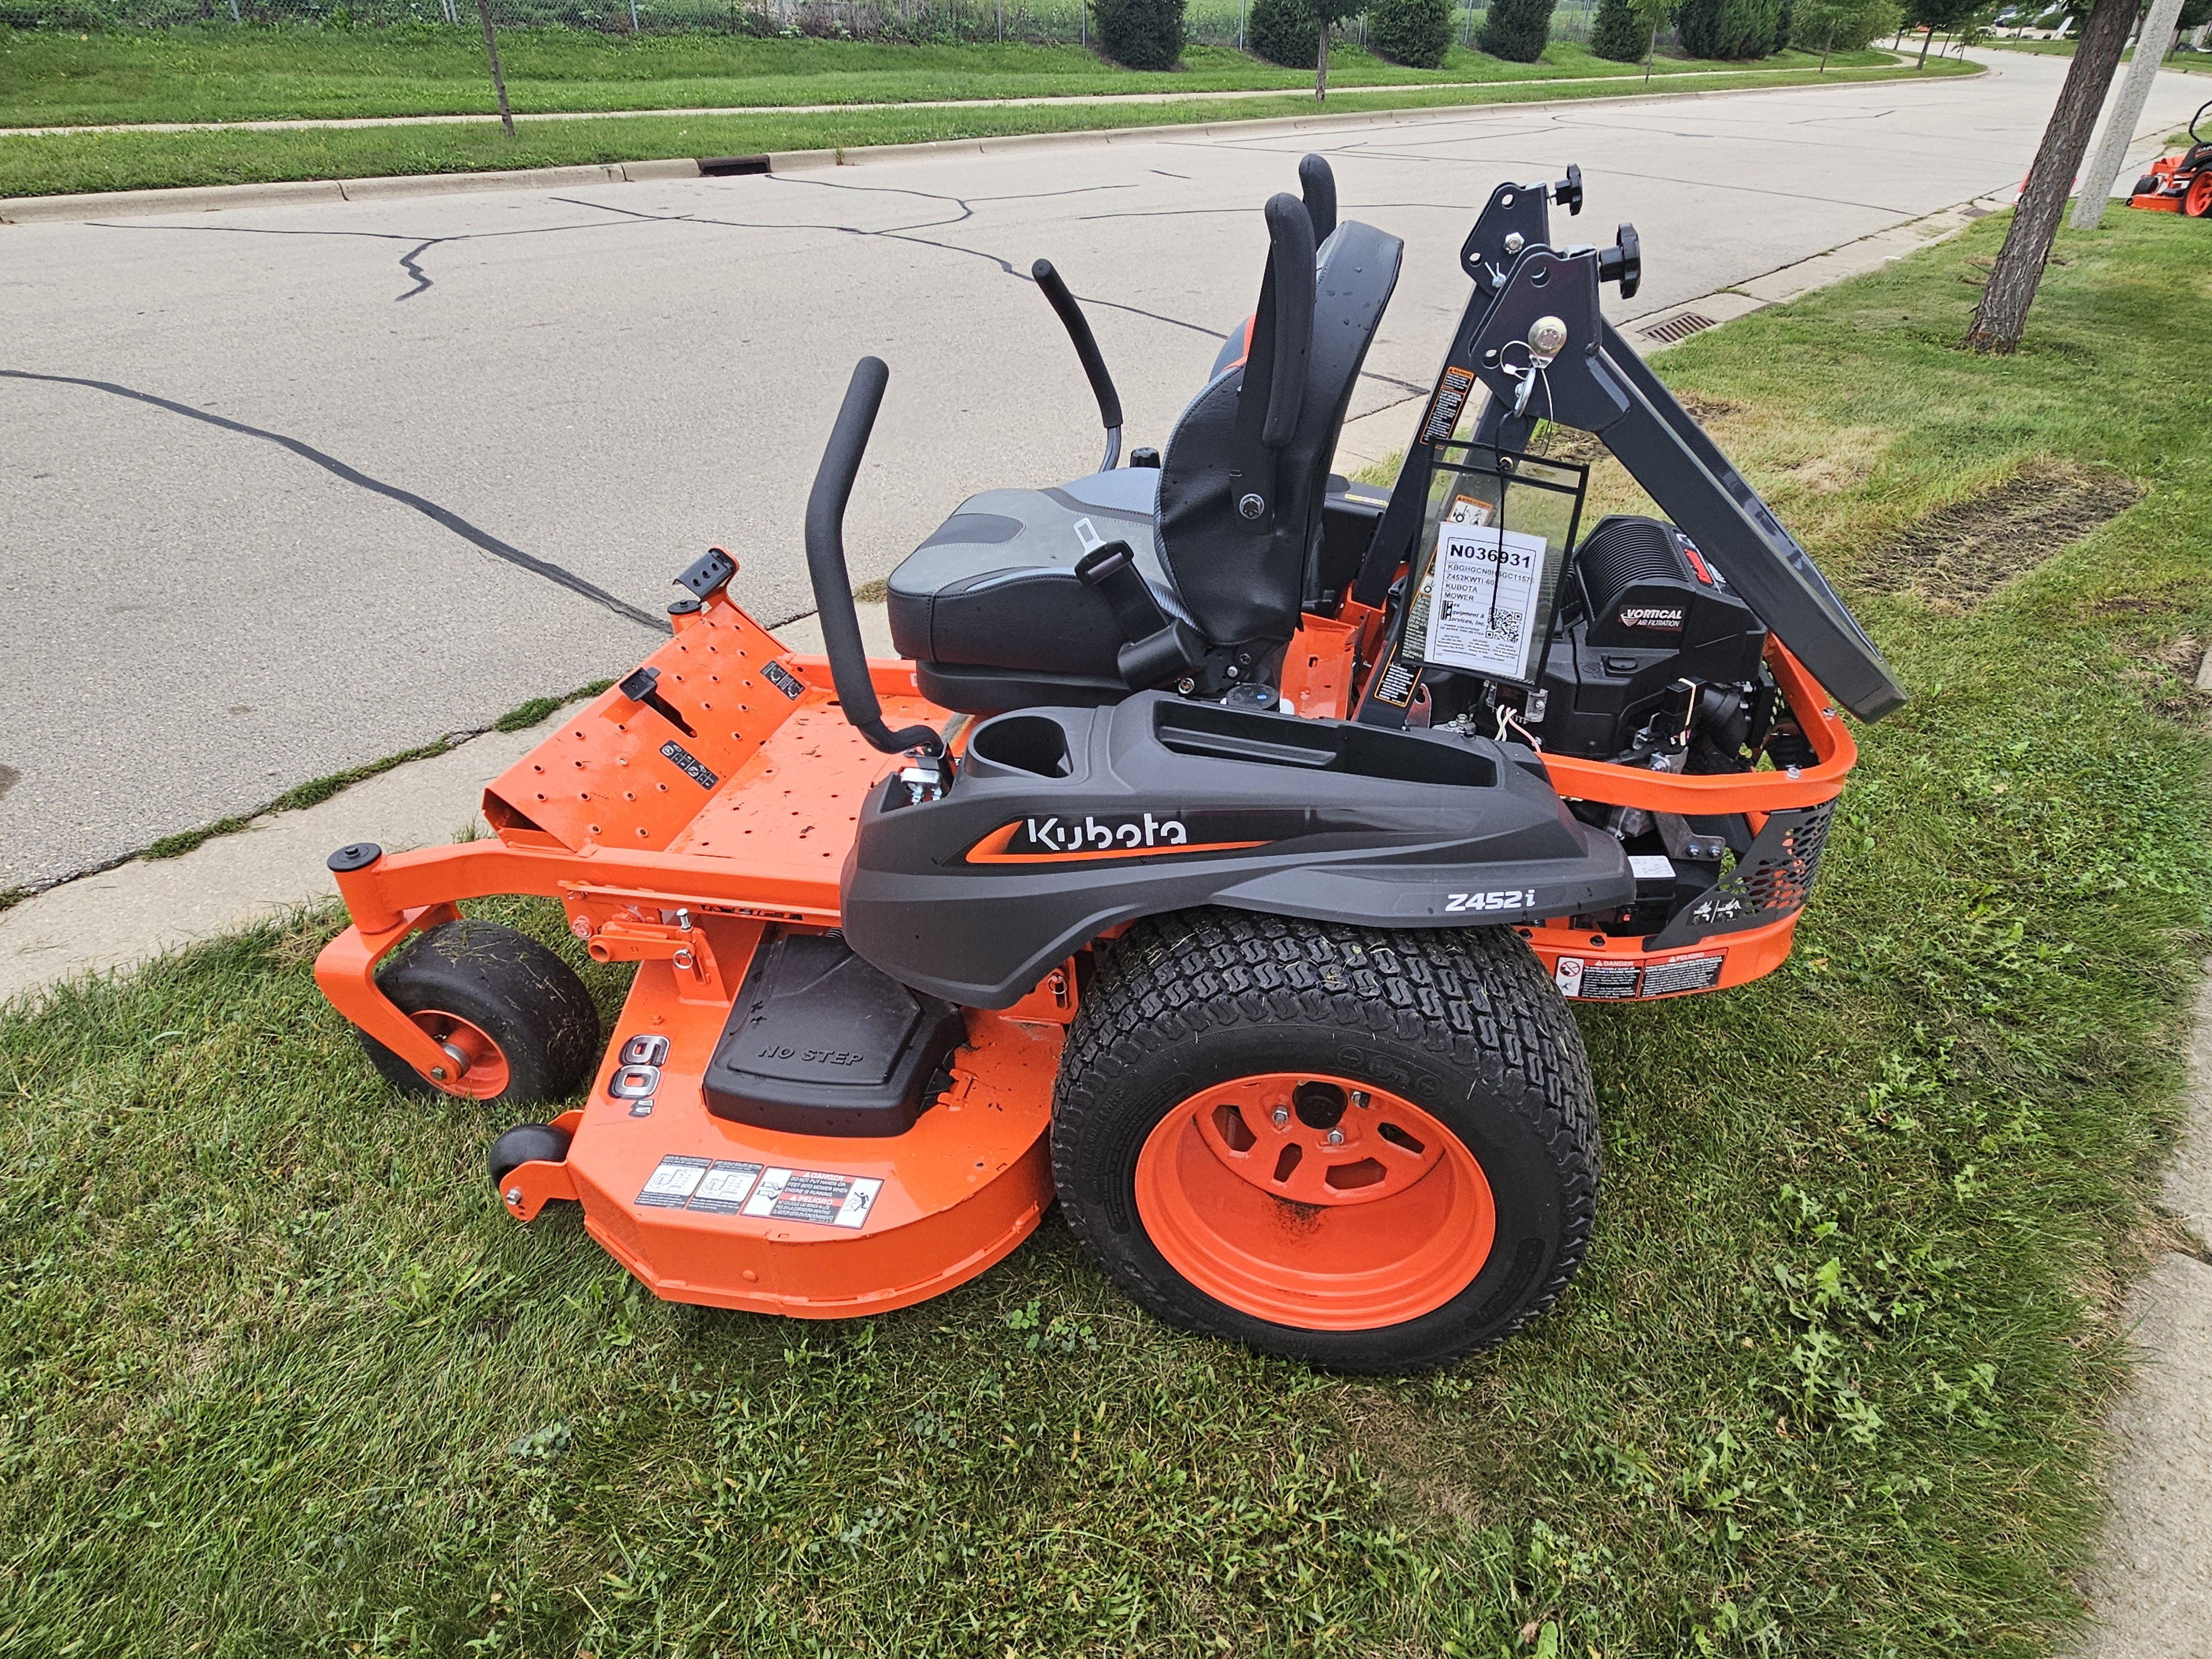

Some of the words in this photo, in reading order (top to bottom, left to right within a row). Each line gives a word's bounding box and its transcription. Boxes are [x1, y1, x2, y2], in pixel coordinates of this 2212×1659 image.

[1451, 544, 1530, 568] N036931
[1446, 583, 1478, 593] KUBOTA
[1444, 592, 1474, 601] MOWER
[1627, 609, 1682, 619] VORTICAL
[1027, 813, 1187, 851] Kubota
[1445, 889, 1536, 911] Z452i
[1676, 952, 1705, 961] PELIGRO
[758, 1045, 795, 1059] NO
[801, 1049, 864, 1066] STEP
[810, 1172, 845, 1181] DANGER
[799, 1196, 834, 1205] PELIGRO
